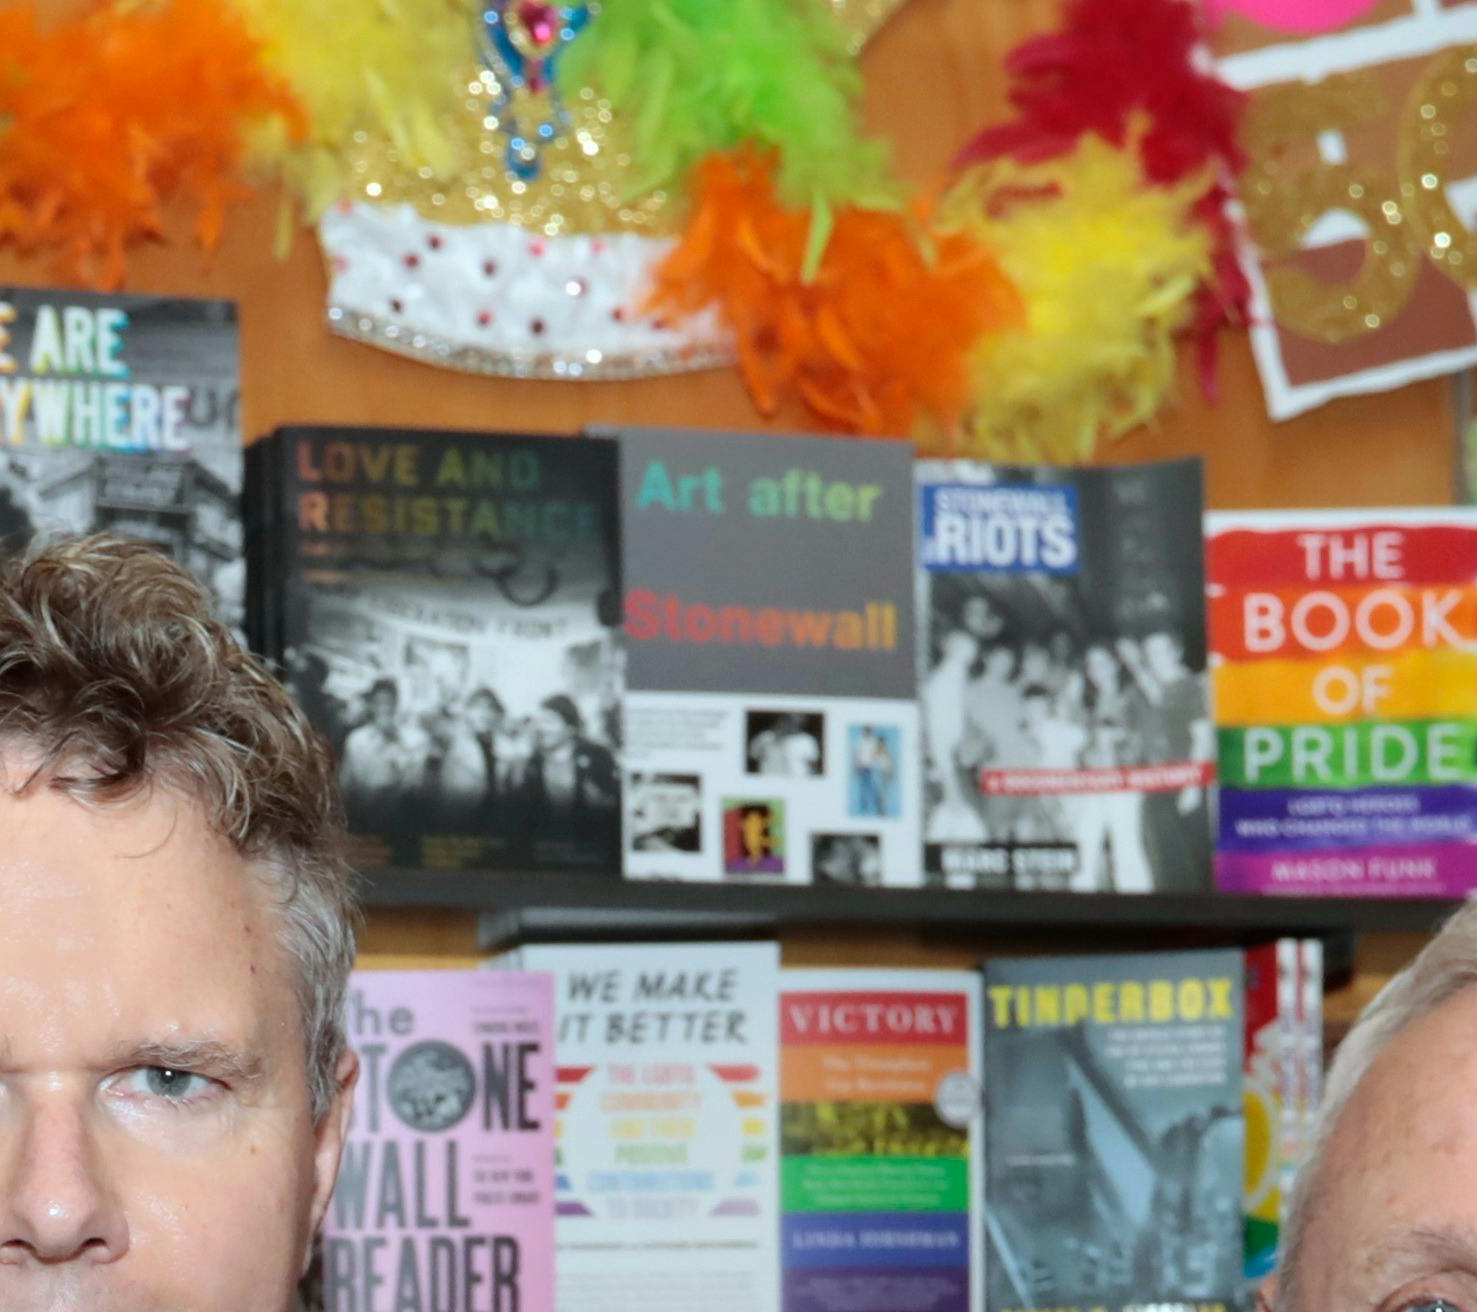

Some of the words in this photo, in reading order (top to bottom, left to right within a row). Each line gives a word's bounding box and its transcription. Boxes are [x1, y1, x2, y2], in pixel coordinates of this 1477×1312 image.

[30, 306, 131, 373] ARE
[295, 441, 420, 487] LOVE
[434, 443, 540, 491] AND
[297, 491, 598, 538] RESISTANCE
[636, 461, 723, 512] Art
[748, 468, 883, 523] after
[934, 518, 1077, 568] RIOTS
[1298, 533, 1406, 580] THE
[623, 589, 898, 651] Stonewall
[1244, 589, 1466, 652] BOOK
[1312, 664, 1394, 716] OF
[1243, 722, 1472, 782] PRIDE
[1271, 857, 1365, 882] MASON
[1367, 855, 1437, 880] FUNK
[567, 970, 623, 1002] WE
[631, 967, 740, 1002] MAKE
[987, 976, 1234, 1028] TINDERBOX
[558, 1012, 594, 1043] IT
[604, 1010, 747, 1045] BETTER
[789, 1002, 957, 1036] VICTORY
[335, 1139, 472, 1232] WALL
